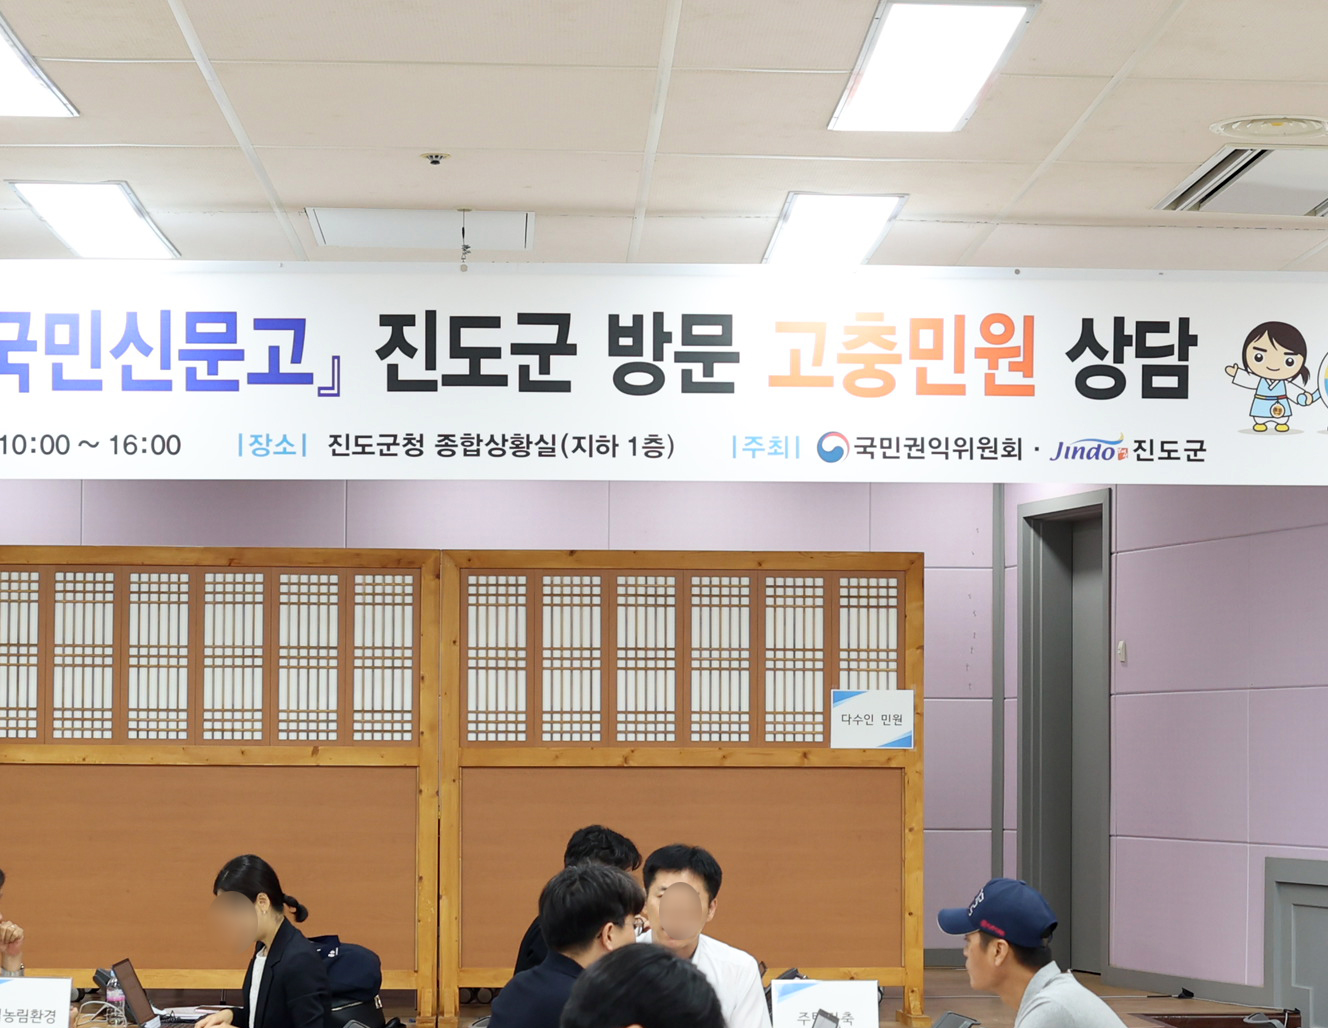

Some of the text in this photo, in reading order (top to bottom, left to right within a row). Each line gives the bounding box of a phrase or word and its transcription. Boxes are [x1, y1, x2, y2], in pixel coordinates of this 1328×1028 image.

[374, 308, 578, 394] 진도군
[607, 310, 741, 397] 방문
[768, 313, 1036, 399] 고충민원
[1064, 315, 1199, 401] 상담
[109, 433, 182, 456] 16:00
[327, 432, 425, 458] 진도군청
[434, 432, 620, 460] 종합상황실(지하
[627, 433, 675, 460] 1층)
[853, 436, 1023, 462] 국민권익위원회
[1049, 441, 1116, 462] Jindo
[1132, 438, 1208, 463] 진도군
[841, 713, 903, 726] 다수인 민원
